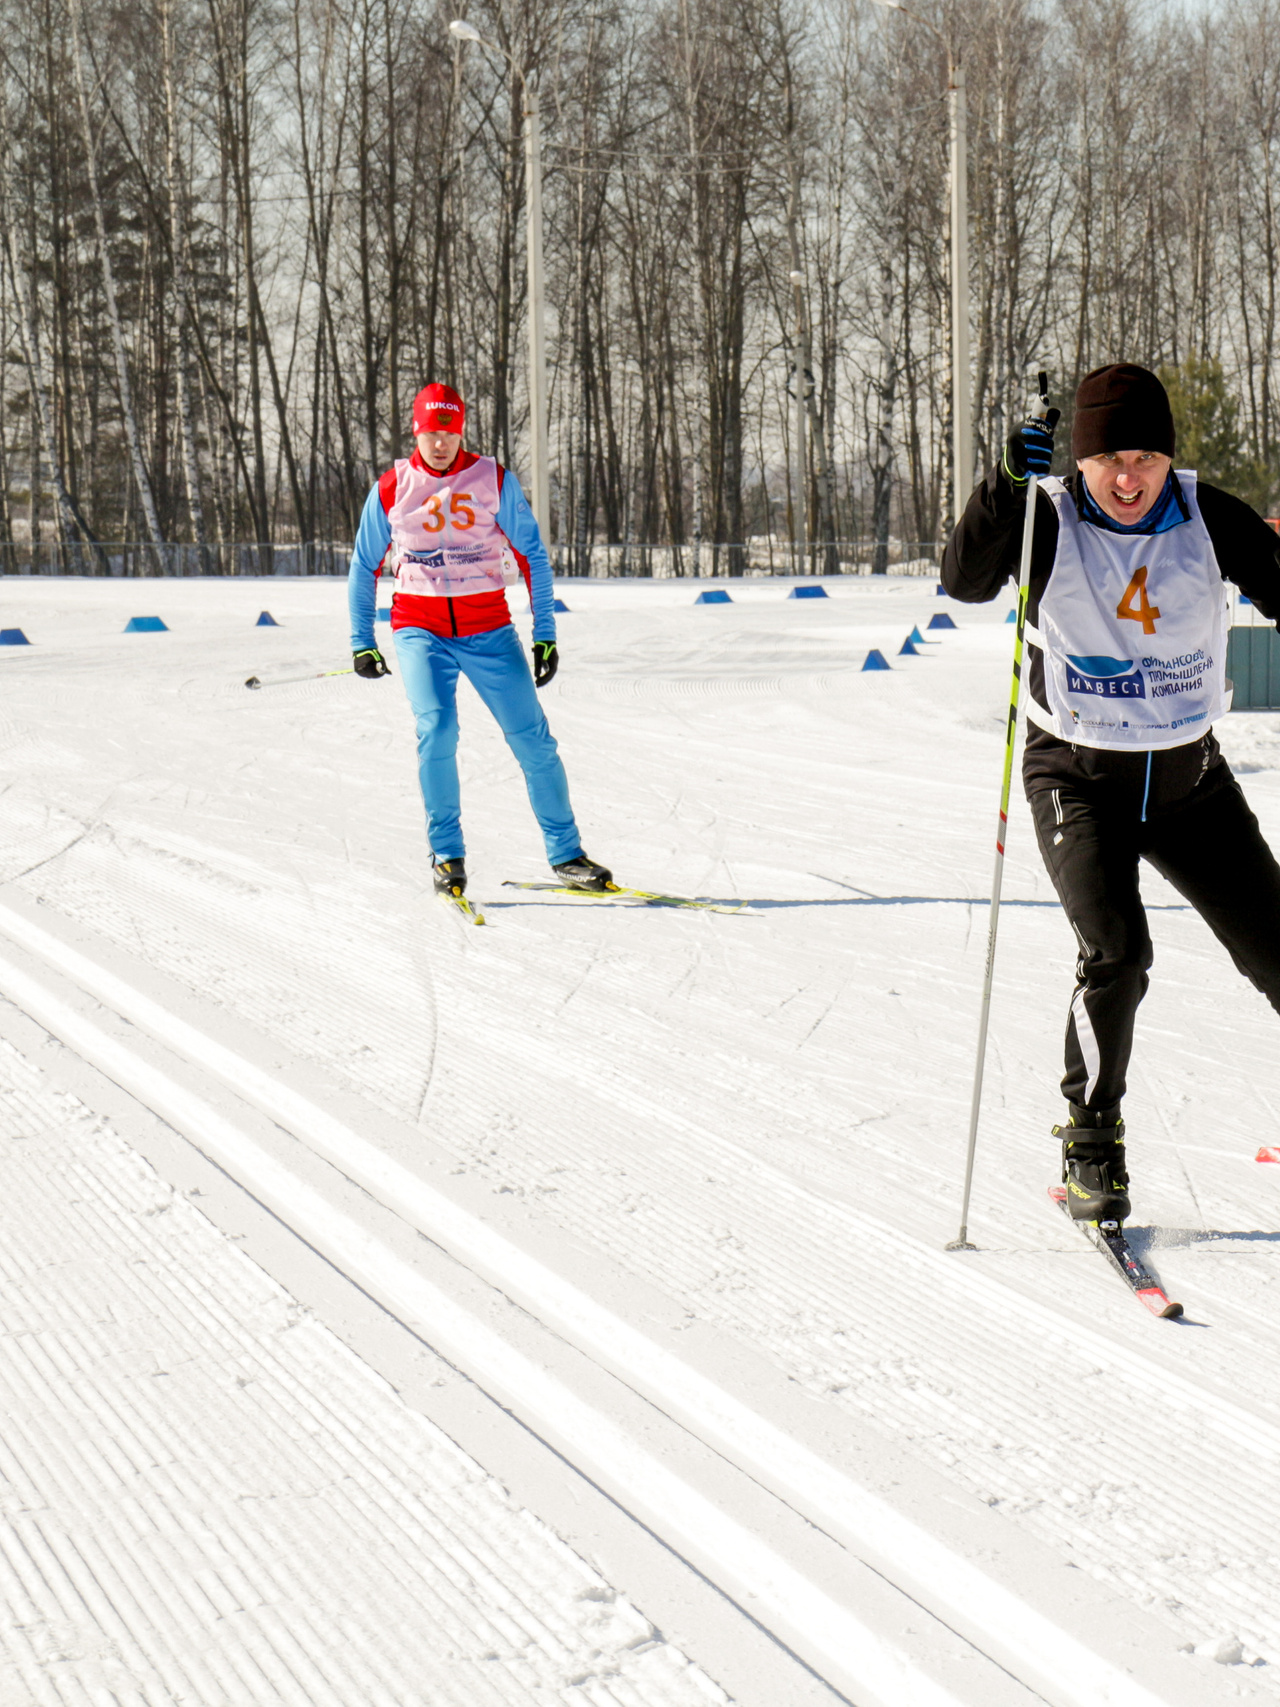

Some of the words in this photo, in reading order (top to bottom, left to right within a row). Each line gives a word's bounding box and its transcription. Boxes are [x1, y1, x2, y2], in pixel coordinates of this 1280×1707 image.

[425, 401, 460, 413] LUKOIL
[422, 493, 475, 533] 35
[1117, 565, 1161, 635] 4
[1151, 677, 1203, 698] КОМПАНИЯ
